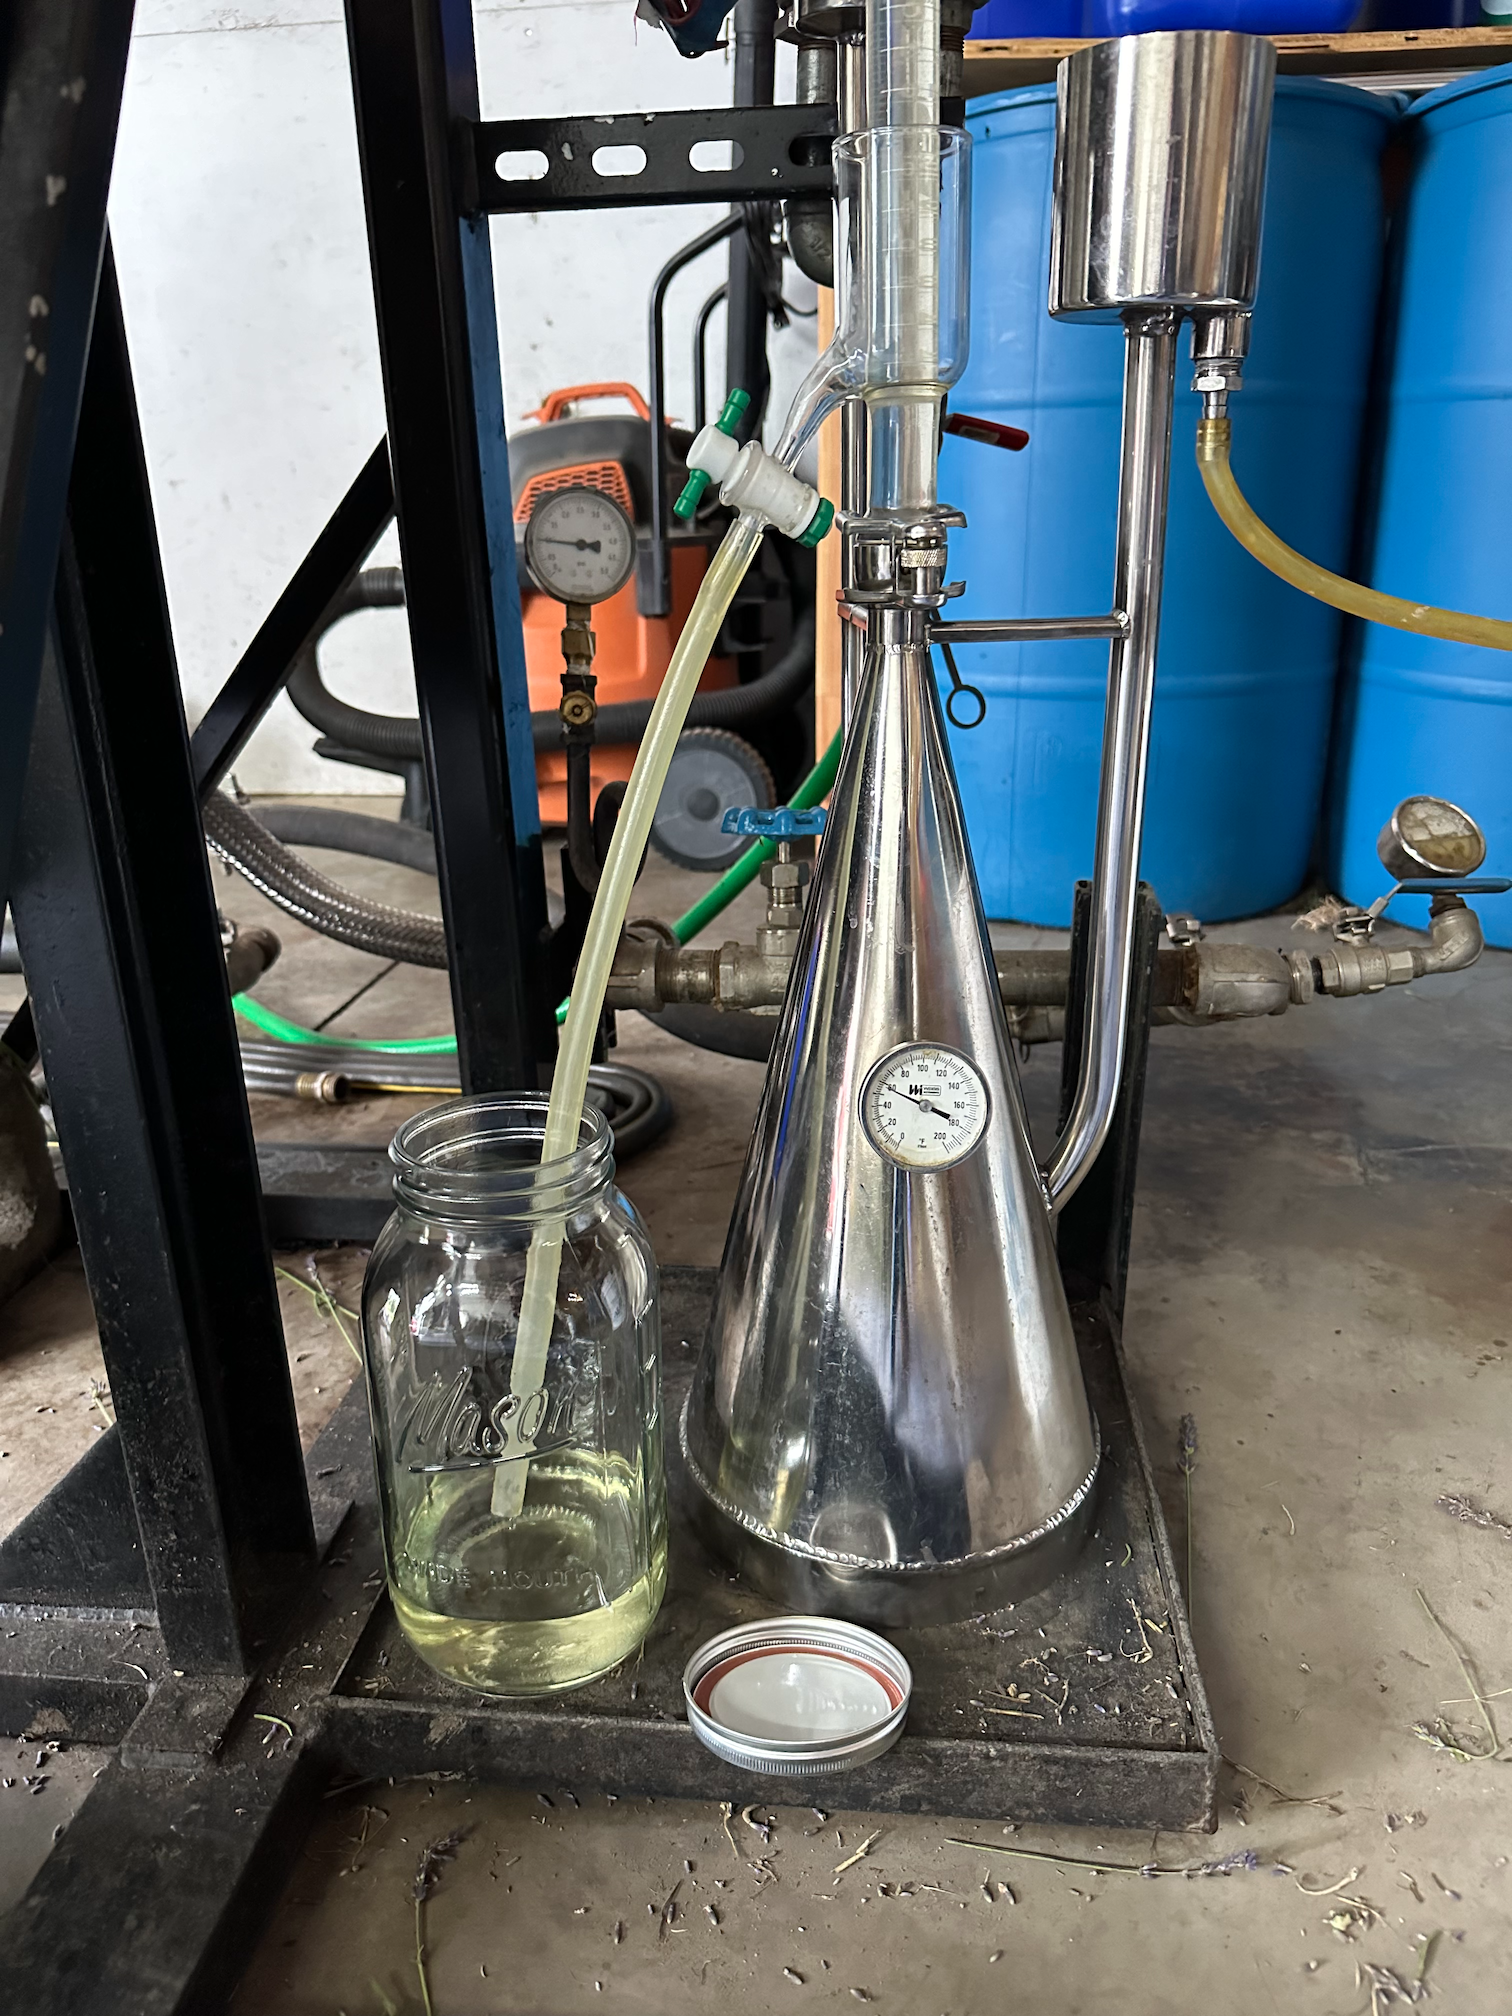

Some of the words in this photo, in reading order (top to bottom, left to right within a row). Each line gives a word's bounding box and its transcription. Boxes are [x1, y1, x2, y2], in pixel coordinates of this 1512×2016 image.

[901, 1070, 910, 1078] 80
[936, 1069, 947, 1077] 120
[948, 1082, 960, 1090] 140
[883, 1101, 892, 1109] 40
[954, 1101, 965, 1109] 160
[888, 1118, 897, 1126] 20
[948, 1118, 960, 1127] 180
[934, 1132, 947, 1140] 200
[396, 1364, 579, 1463] Mason
[405, 1555, 472, 1589] WIDE
